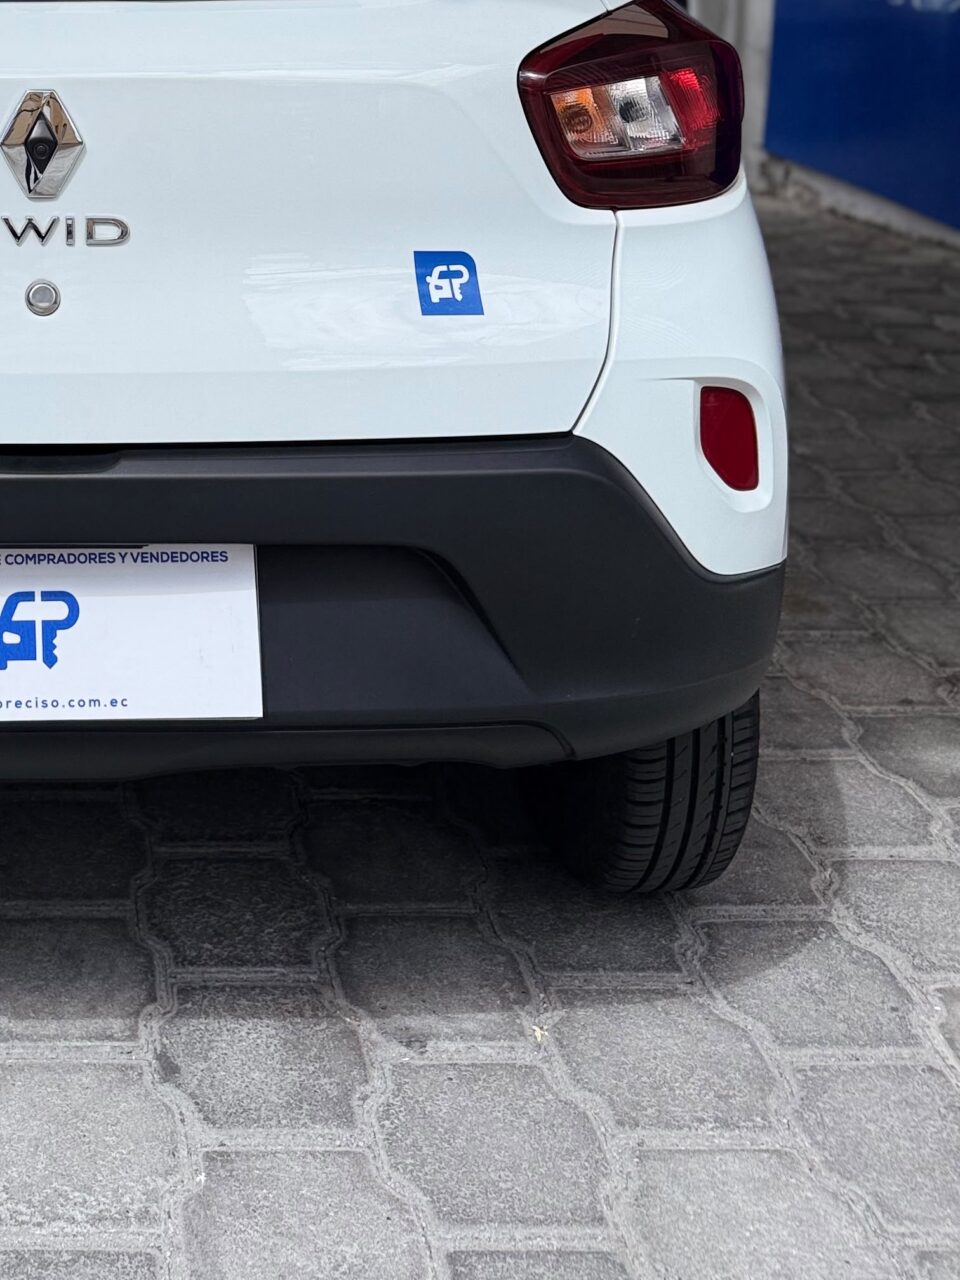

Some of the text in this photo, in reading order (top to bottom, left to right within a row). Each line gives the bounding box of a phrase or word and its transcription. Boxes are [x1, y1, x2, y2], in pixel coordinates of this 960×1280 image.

[4, 551, 116, 566] COMPRADORES
[115, 551, 128, 564] Y
[129, 550, 229, 563] VENDEDORES
